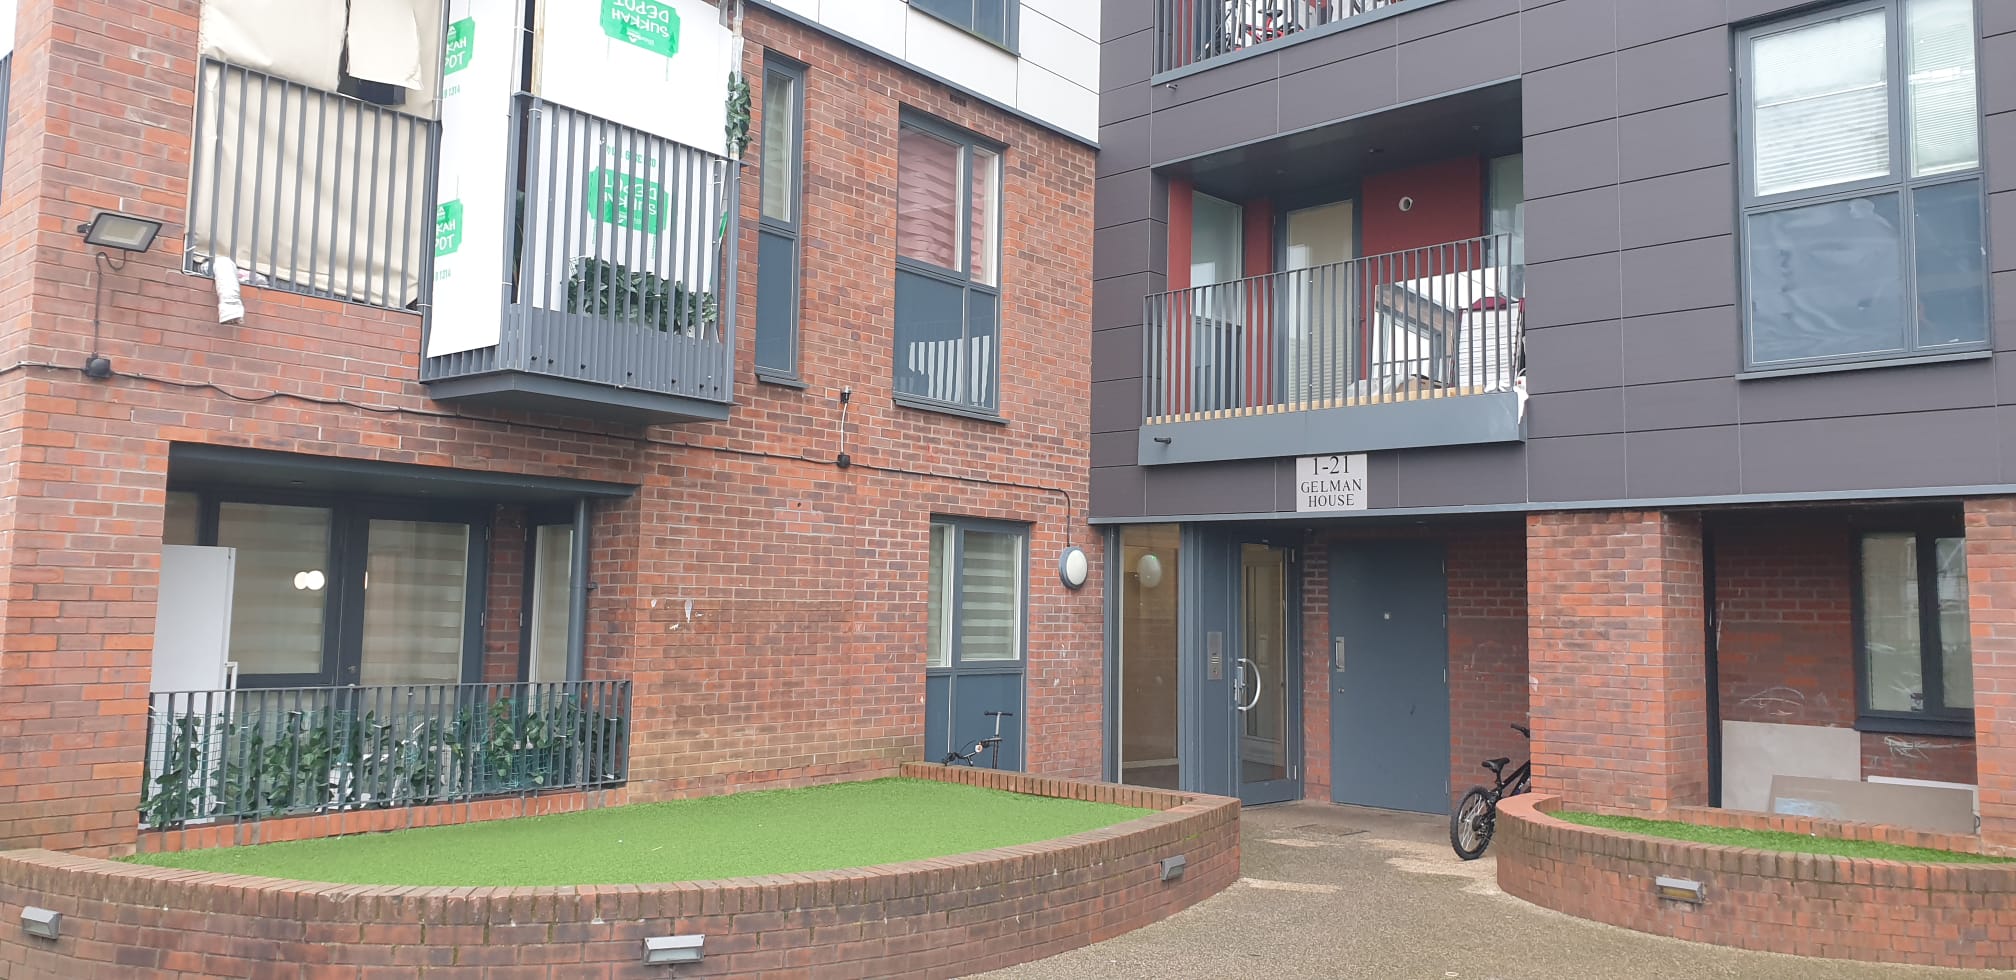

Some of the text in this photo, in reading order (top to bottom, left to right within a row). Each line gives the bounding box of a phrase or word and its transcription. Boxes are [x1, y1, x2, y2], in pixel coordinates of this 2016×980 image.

[612, 8, 669, 38] SUKKAH
[1313, 455, 1349, 475] 1-21
[1300, 479, 1362, 493] GELMAN
[1308, 493, 1355, 507] HOUSE
